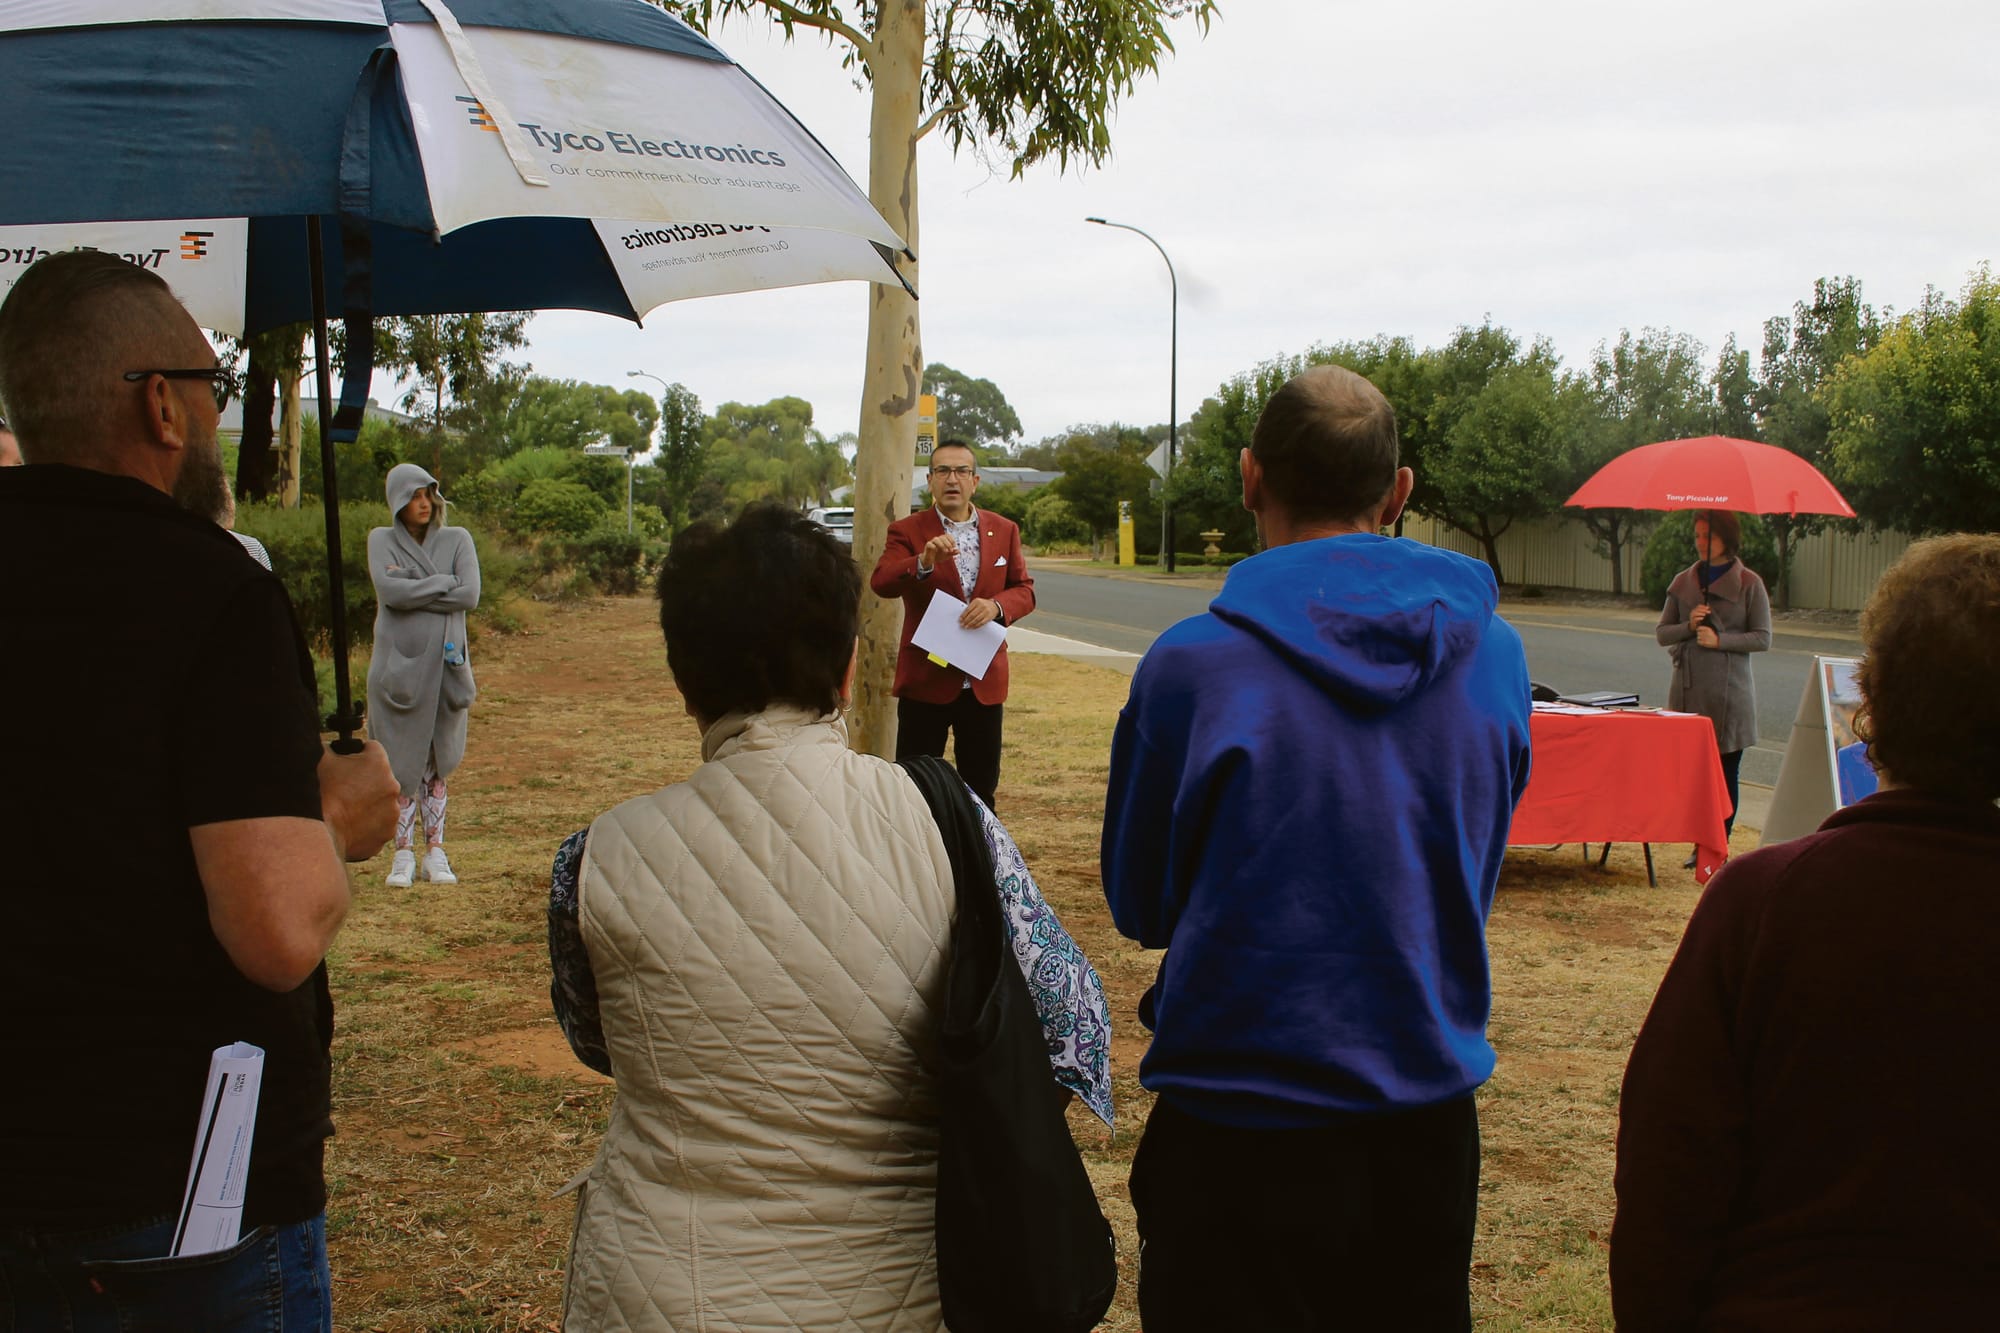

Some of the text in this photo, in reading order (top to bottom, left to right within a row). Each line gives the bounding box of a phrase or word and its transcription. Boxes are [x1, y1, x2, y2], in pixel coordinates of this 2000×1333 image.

[518, 123, 786, 167] Tyco Electronics
[550, 163, 580, 176] Our
[687, 173, 721, 186] Your
[726, 177, 801, 193] advantage
[920, 442, 932, 454] 151
[1666, 494, 1685, 502] Tony
